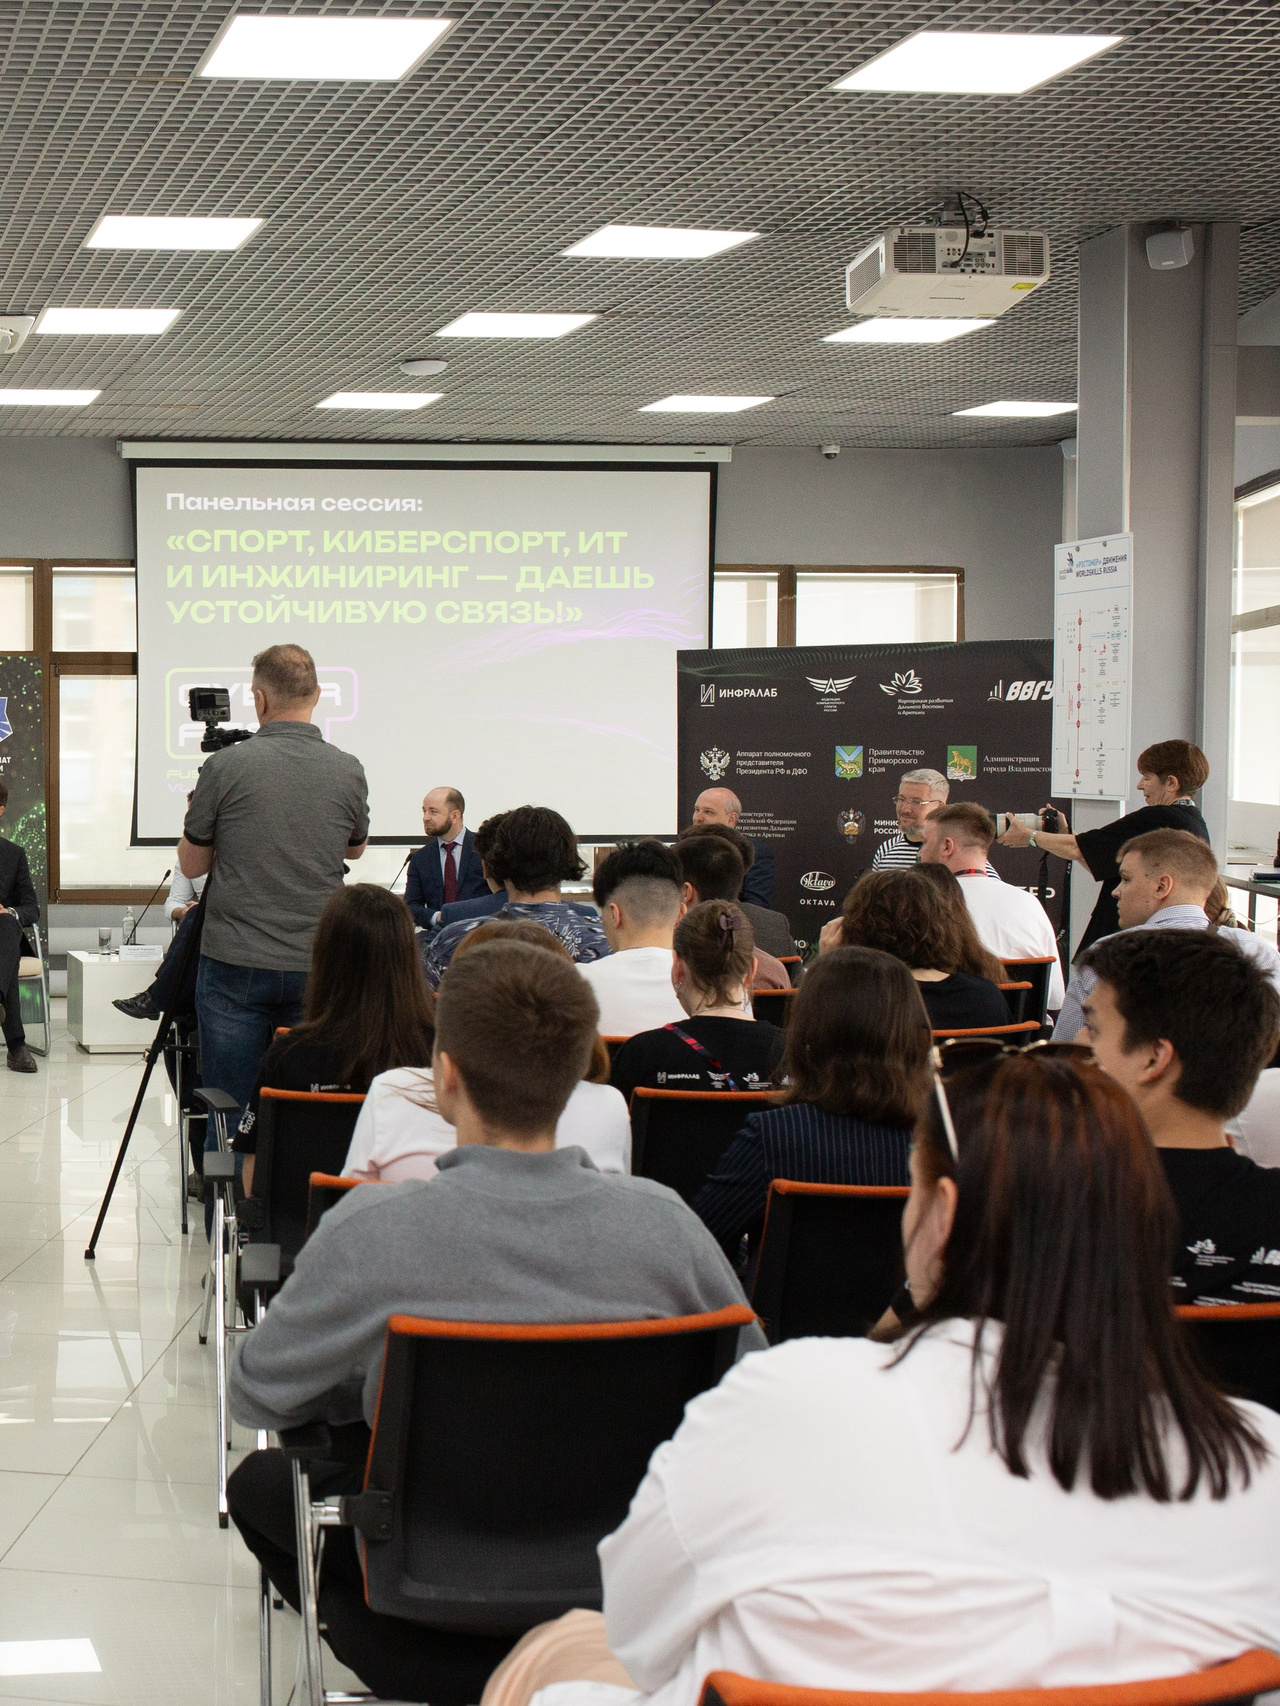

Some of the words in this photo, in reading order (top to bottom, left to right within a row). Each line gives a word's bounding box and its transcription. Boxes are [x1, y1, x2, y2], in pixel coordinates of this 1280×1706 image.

[166, 493, 315, 511] Панельная
[321, 498, 423, 512] сессия:
[166, 529, 314, 556] «СПОРТ,
[323, 530, 571, 557] КИБЕРСПОРТ,
[578, 531, 628, 554] ИТ
[167, 565, 193, 588] И
[202, 565, 469, 588] ИНЖИНИРИНГ
[515, 566, 655, 592] ДАЕШЬ
[166, 594, 427, 624] УСТОЙЧИВУЮ
[435, 601, 583, 624] СВЯЗЬ!»
[719, 688, 778, 698] ИНФРАЛАБ
[736, 750, 763, 758] Аппарат
[869, 748, 925, 757] Правительство
[869, 757, 919, 765] Приморского
[983, 755, 1040, 764] Администрация
[791, 768, 808, 776] ДФО
[800, 898, 836, 906] OKTAVA
